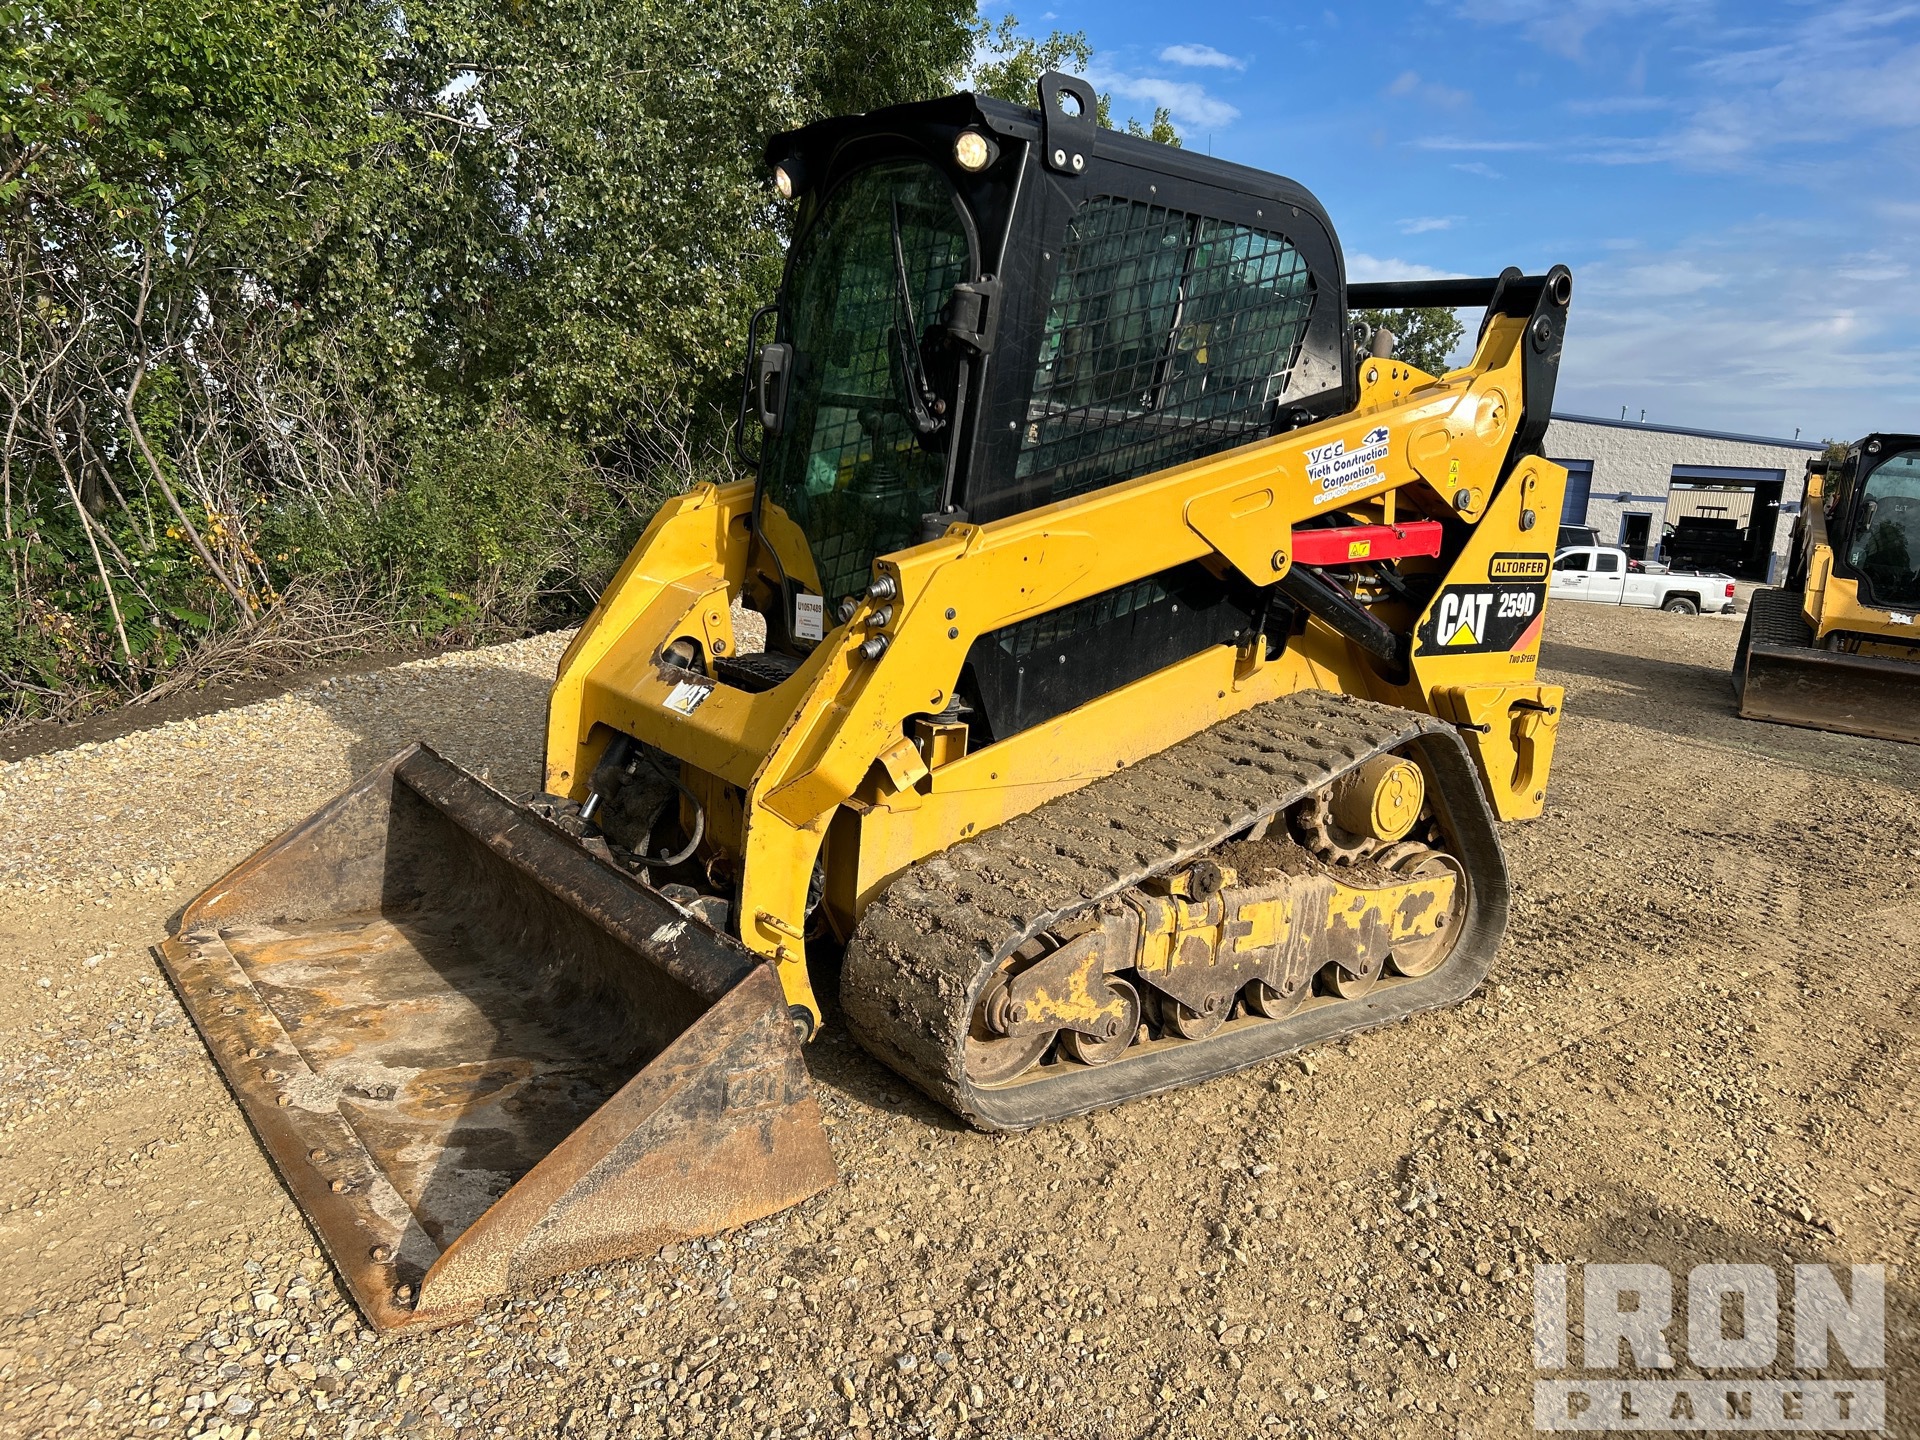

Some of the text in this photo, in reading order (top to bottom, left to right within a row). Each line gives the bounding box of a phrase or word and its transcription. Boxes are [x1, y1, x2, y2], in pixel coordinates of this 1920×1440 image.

[1308, 447, 1388, 480] Vieth Construction
[1323, 465, 1375, 489] Corporation
[1495, 562, 1544, 573] ALTORFER
[1437, 592, 1536, 646] CAT 259D
